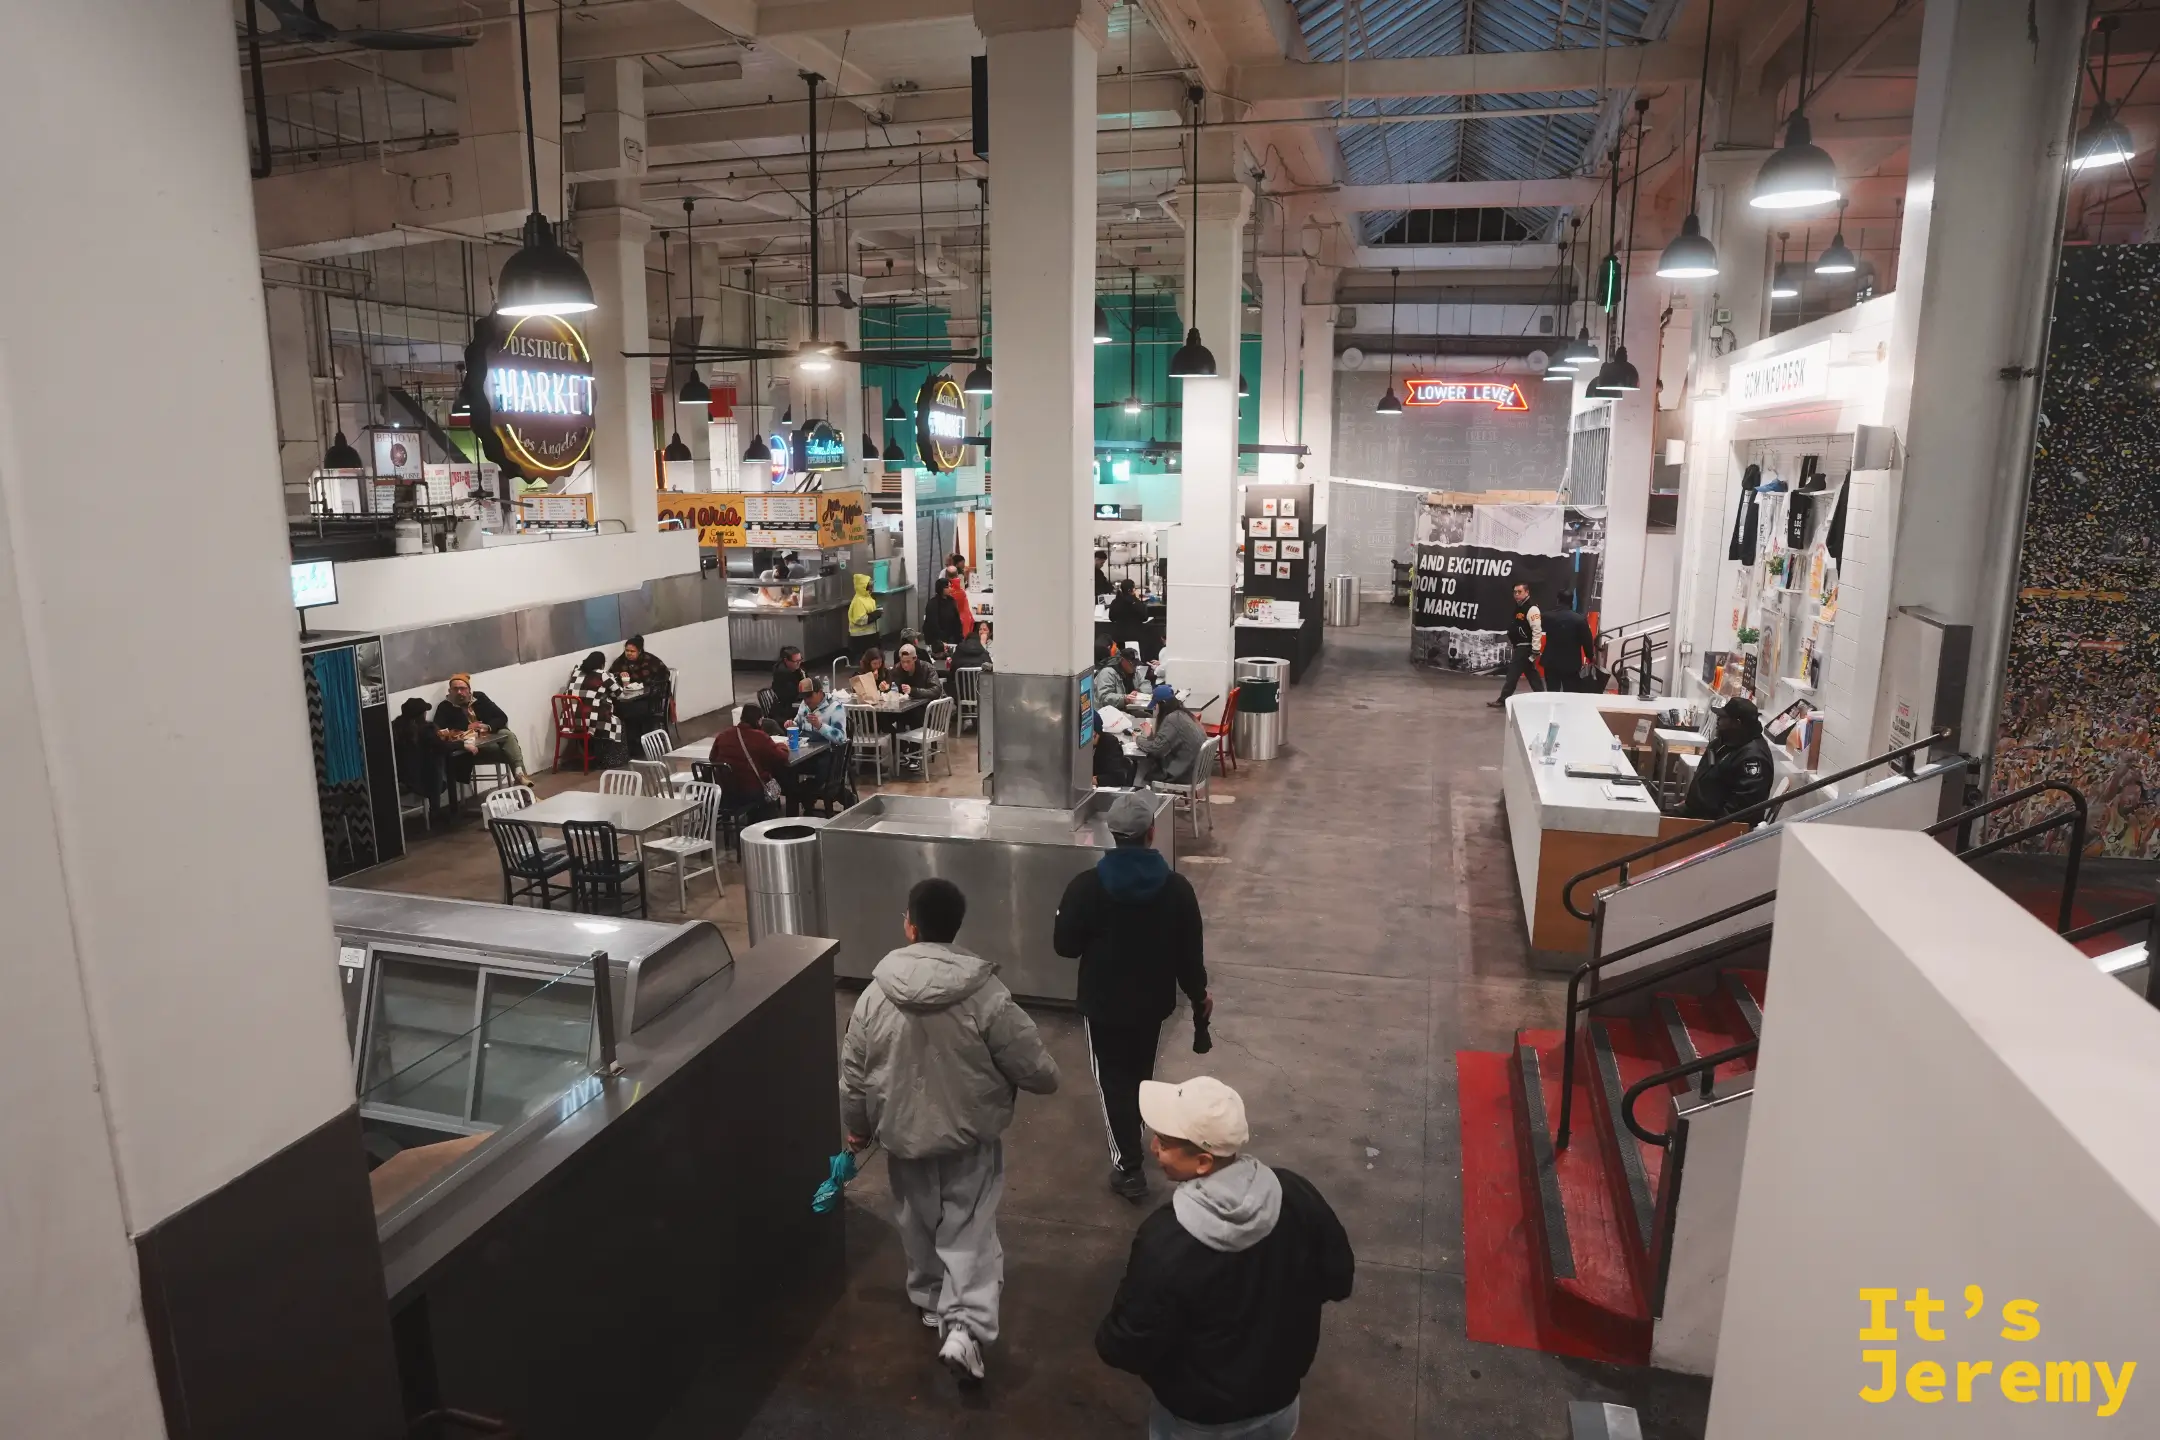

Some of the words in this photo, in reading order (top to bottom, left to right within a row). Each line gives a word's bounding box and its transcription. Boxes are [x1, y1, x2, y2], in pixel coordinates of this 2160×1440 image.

[510, 335, 574, 361] DISTRICT
[498, 368, 595, 416] MARKET
[1417, 385, 1466, 400] LOWER
[1473, 386, 1515, 406] LEVEL
[516, 428, 535, 451] Los
[538, 431, 577, 460] Angeles
[1419, 555, 1444, 572] AND
[1447, 556, 1513, 577] EXCITING
[1441, 577, 1457, 595] TO
[1423, 597, 1479, 620] MARKET!
